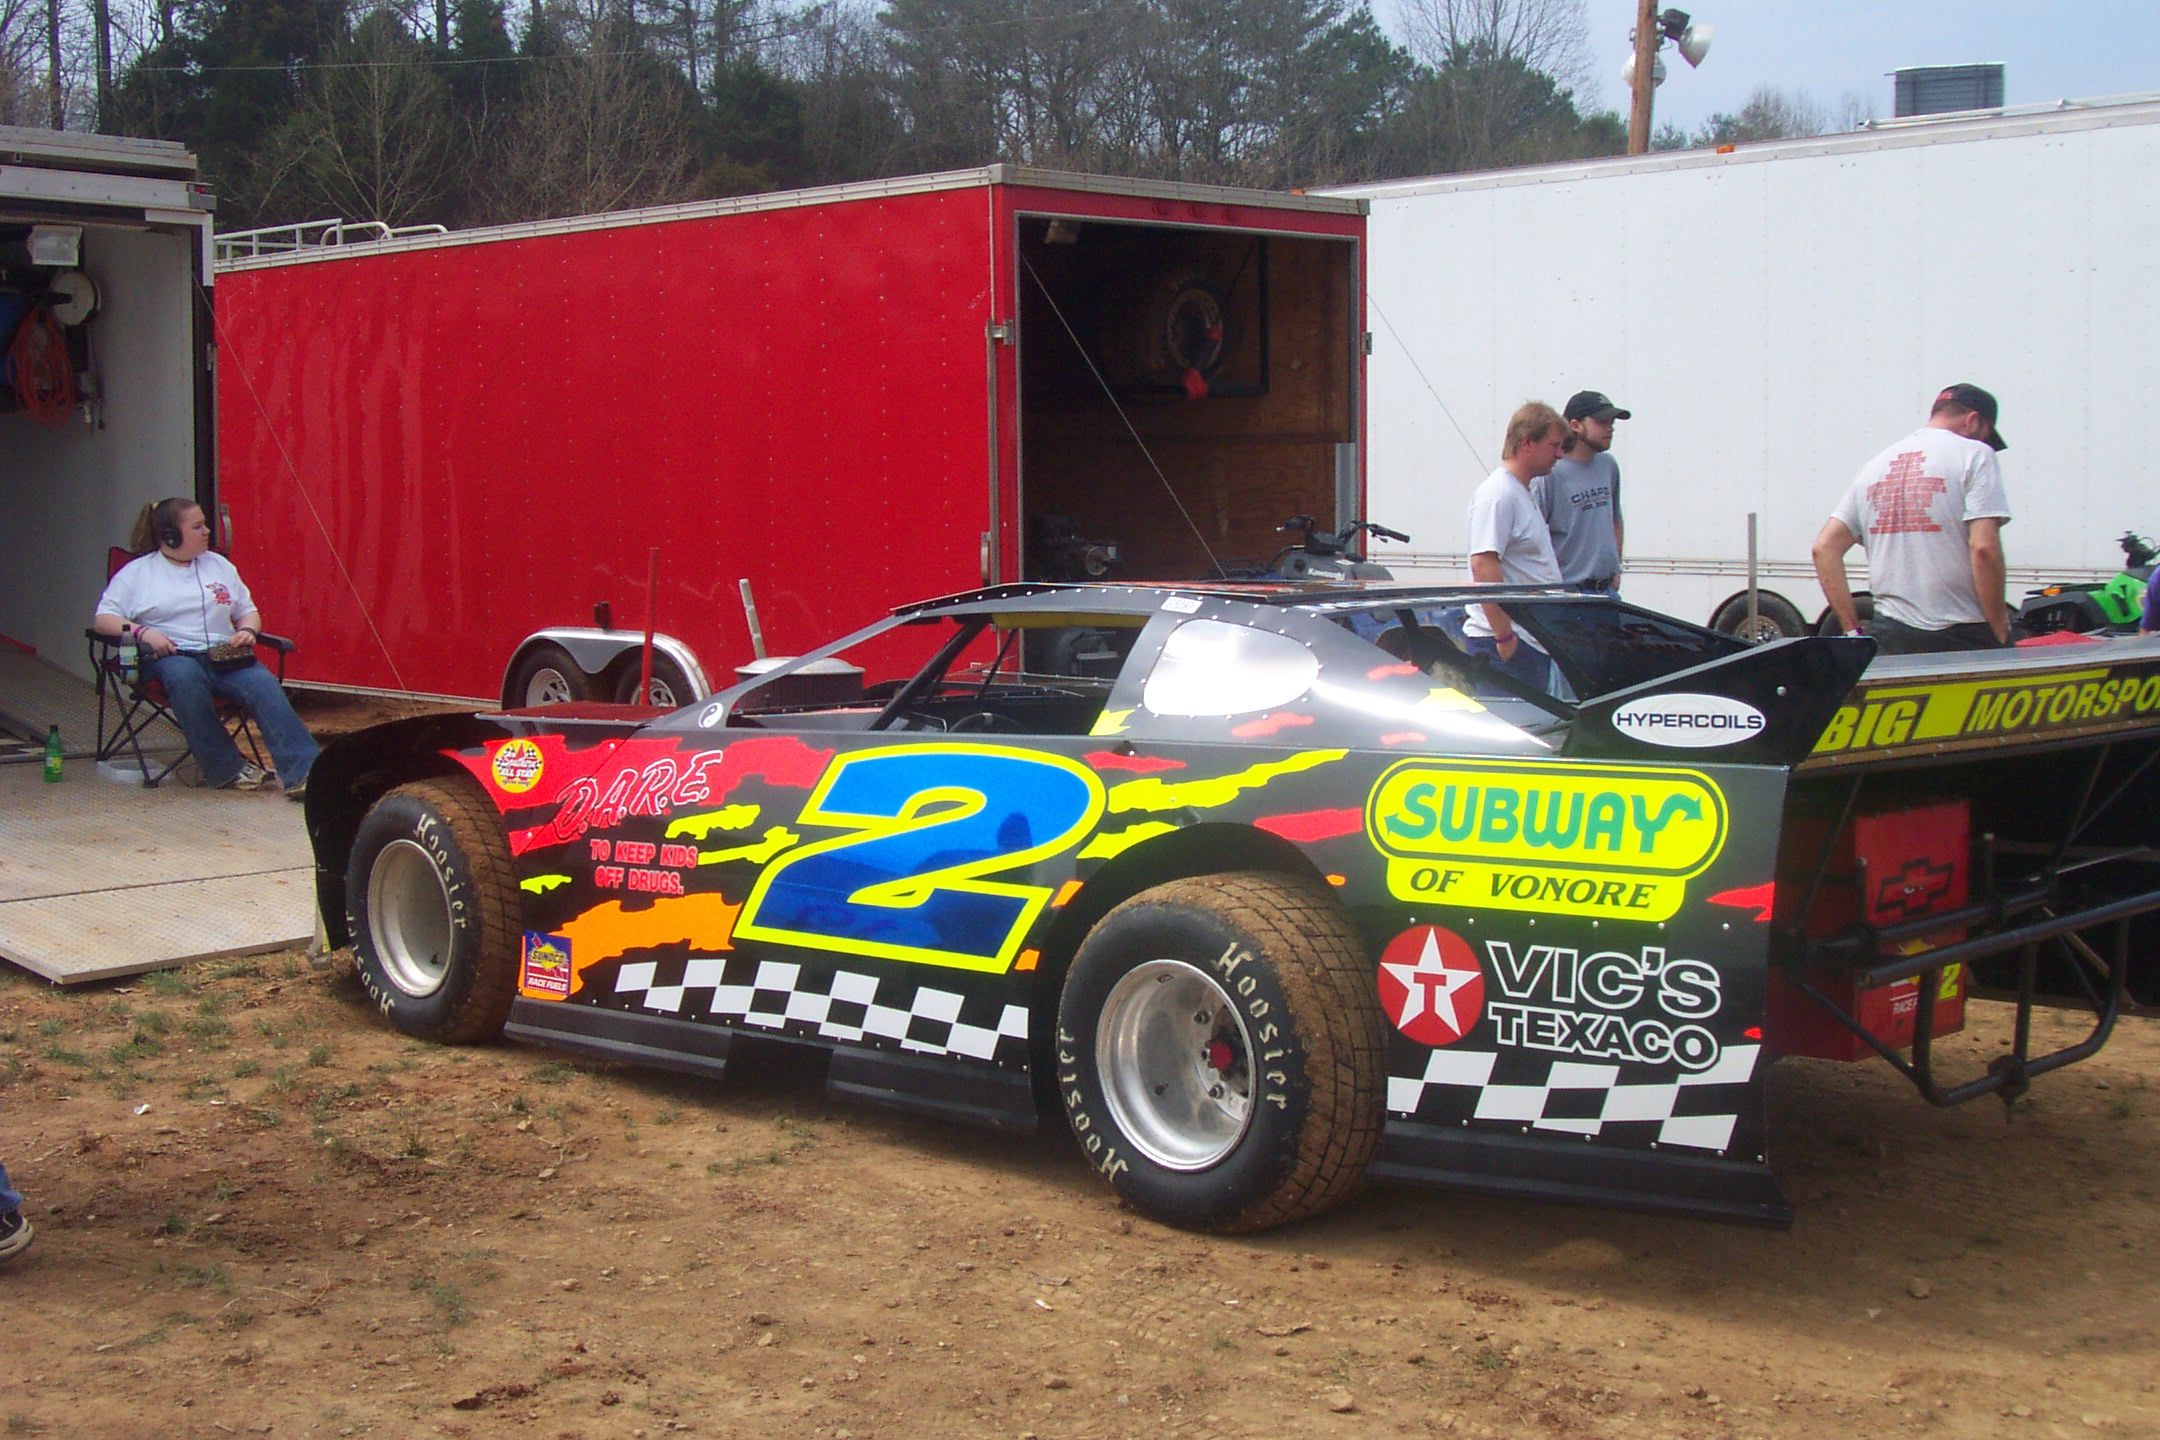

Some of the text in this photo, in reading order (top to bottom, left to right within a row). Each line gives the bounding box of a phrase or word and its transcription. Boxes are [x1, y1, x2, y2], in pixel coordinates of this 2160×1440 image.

[1616, 712, 1763, 730] HYPERCOILS
[1811, 698, 1919, 753] BIG
[1965, 674, 2160, 733] MOTORSPO
[1384, 783, 1703, 853] SUBWAY
[413, 813, 468, 930] Hoosier
[590, 838, 699, 869] TO KEEP KIDS
[594, 865, 685, 896] OFF DRUGS.
[732, 742, 1106, 975] 2
[1410, 868, 1657, 909] OF VONORE
[530, 949, 566, 963] SUNOCO
[1939, 962, 1961, 1001] 2
[1215, 942, 1293, 1109] Hoosier
[1487, 1001, 1720, 1069] TEXACO
